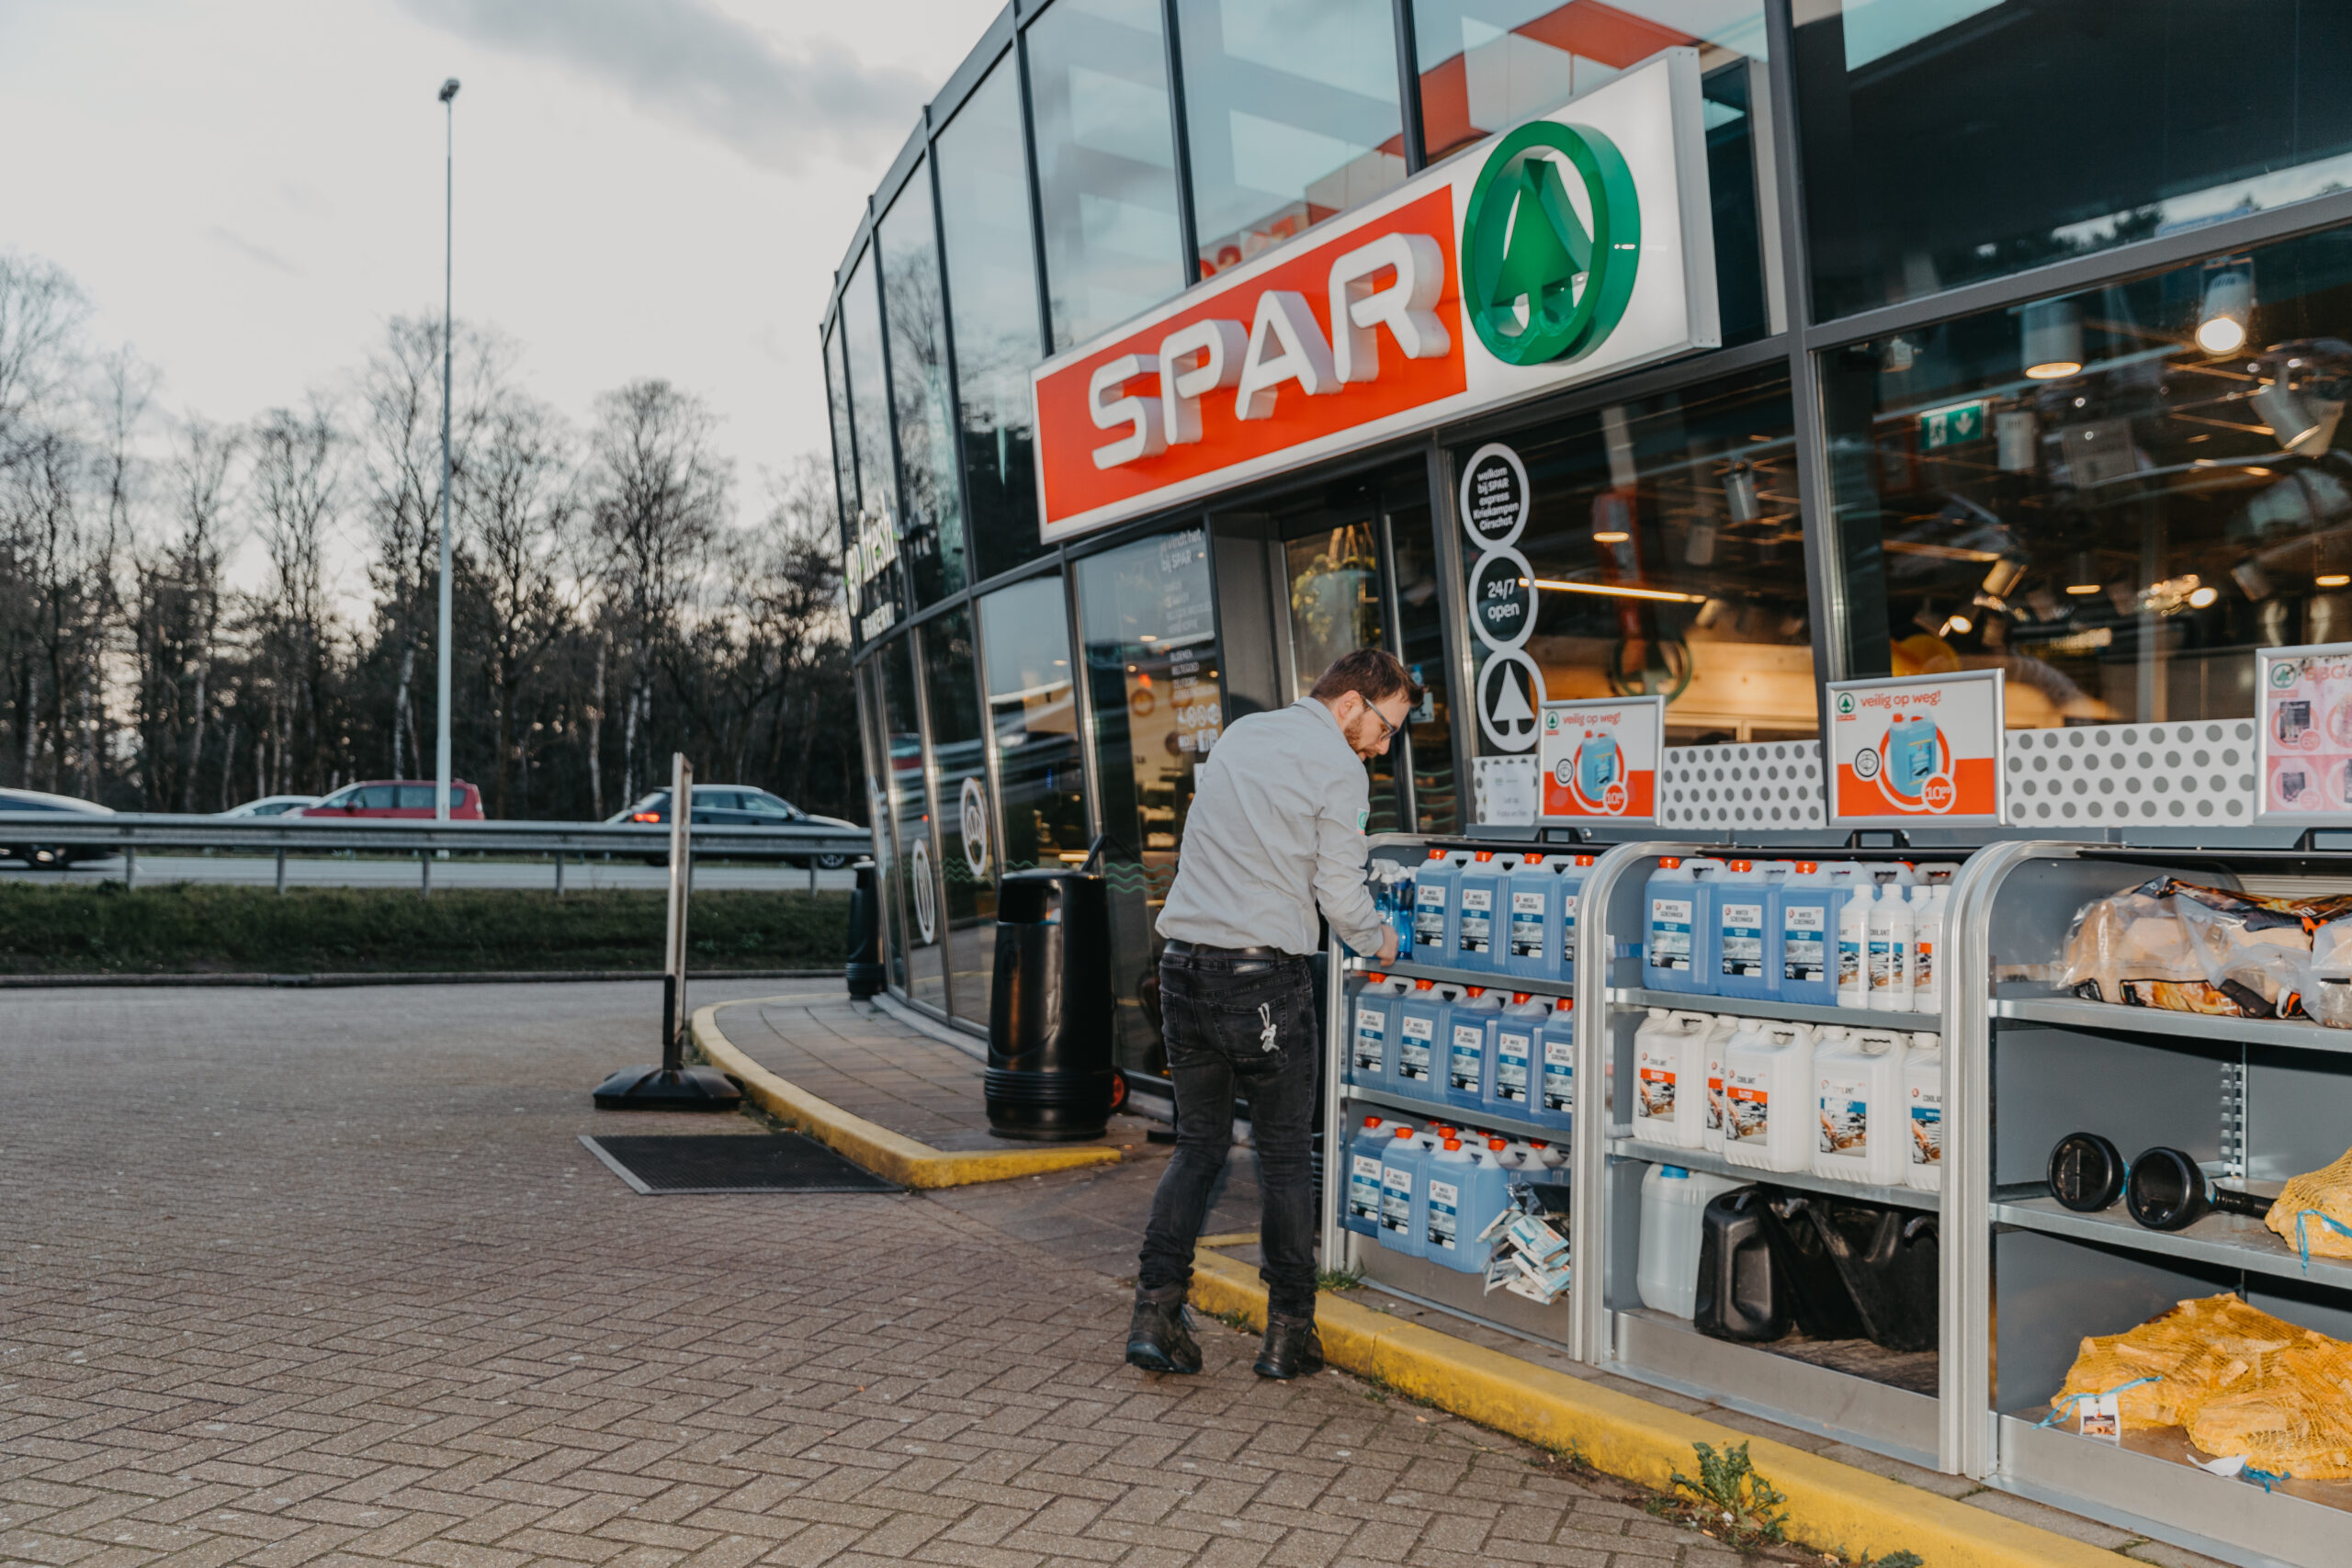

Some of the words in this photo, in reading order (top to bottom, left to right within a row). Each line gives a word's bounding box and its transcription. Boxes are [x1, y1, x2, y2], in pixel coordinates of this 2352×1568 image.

[1089, 232, 1452, 470] SPAR
[1476, 467, 1508, 481] welkom
[1487, 477, 1510, 493] SPAR
[1479, 491, 1510, 508] express
[1487, 578, 1516, 600] 24/7
[1487, 602, 1521, 623] open
[1860, 694, 1892, 709] veilig
[1894, 695, 1910, 707] op
[1912, 690, 1941, 706] weg!
[1563, 713, 1585, 727] veilig
[1586, 715, 1598, 725] op
[1600, 711, 1622, 726] weg!
